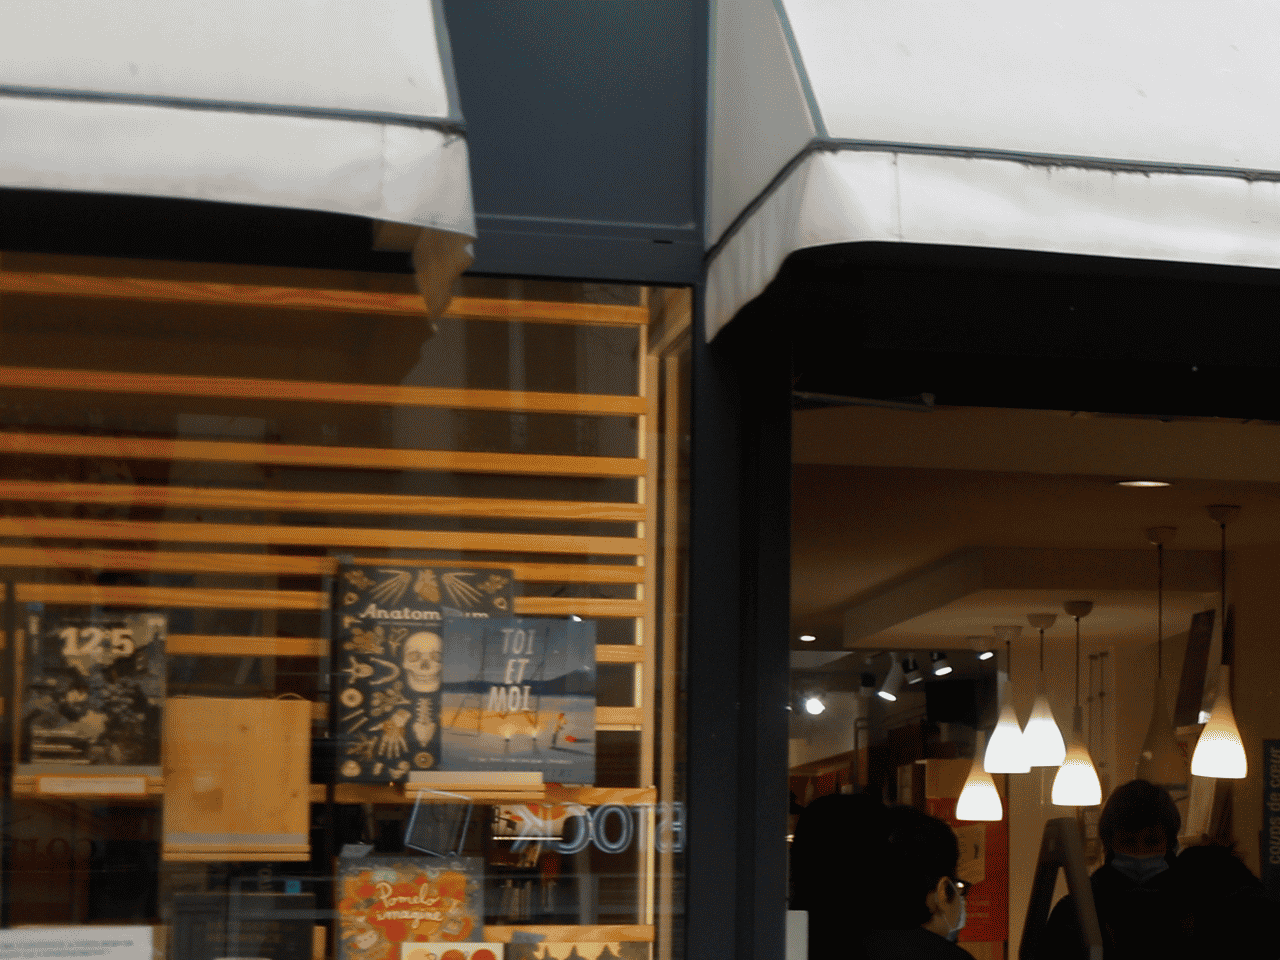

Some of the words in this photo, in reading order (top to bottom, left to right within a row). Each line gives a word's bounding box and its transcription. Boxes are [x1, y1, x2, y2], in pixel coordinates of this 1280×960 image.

[501, 628, 536, 655] TOI
[505, 658, 530, 685] ET
[488, 685, 532, 712] MOI
